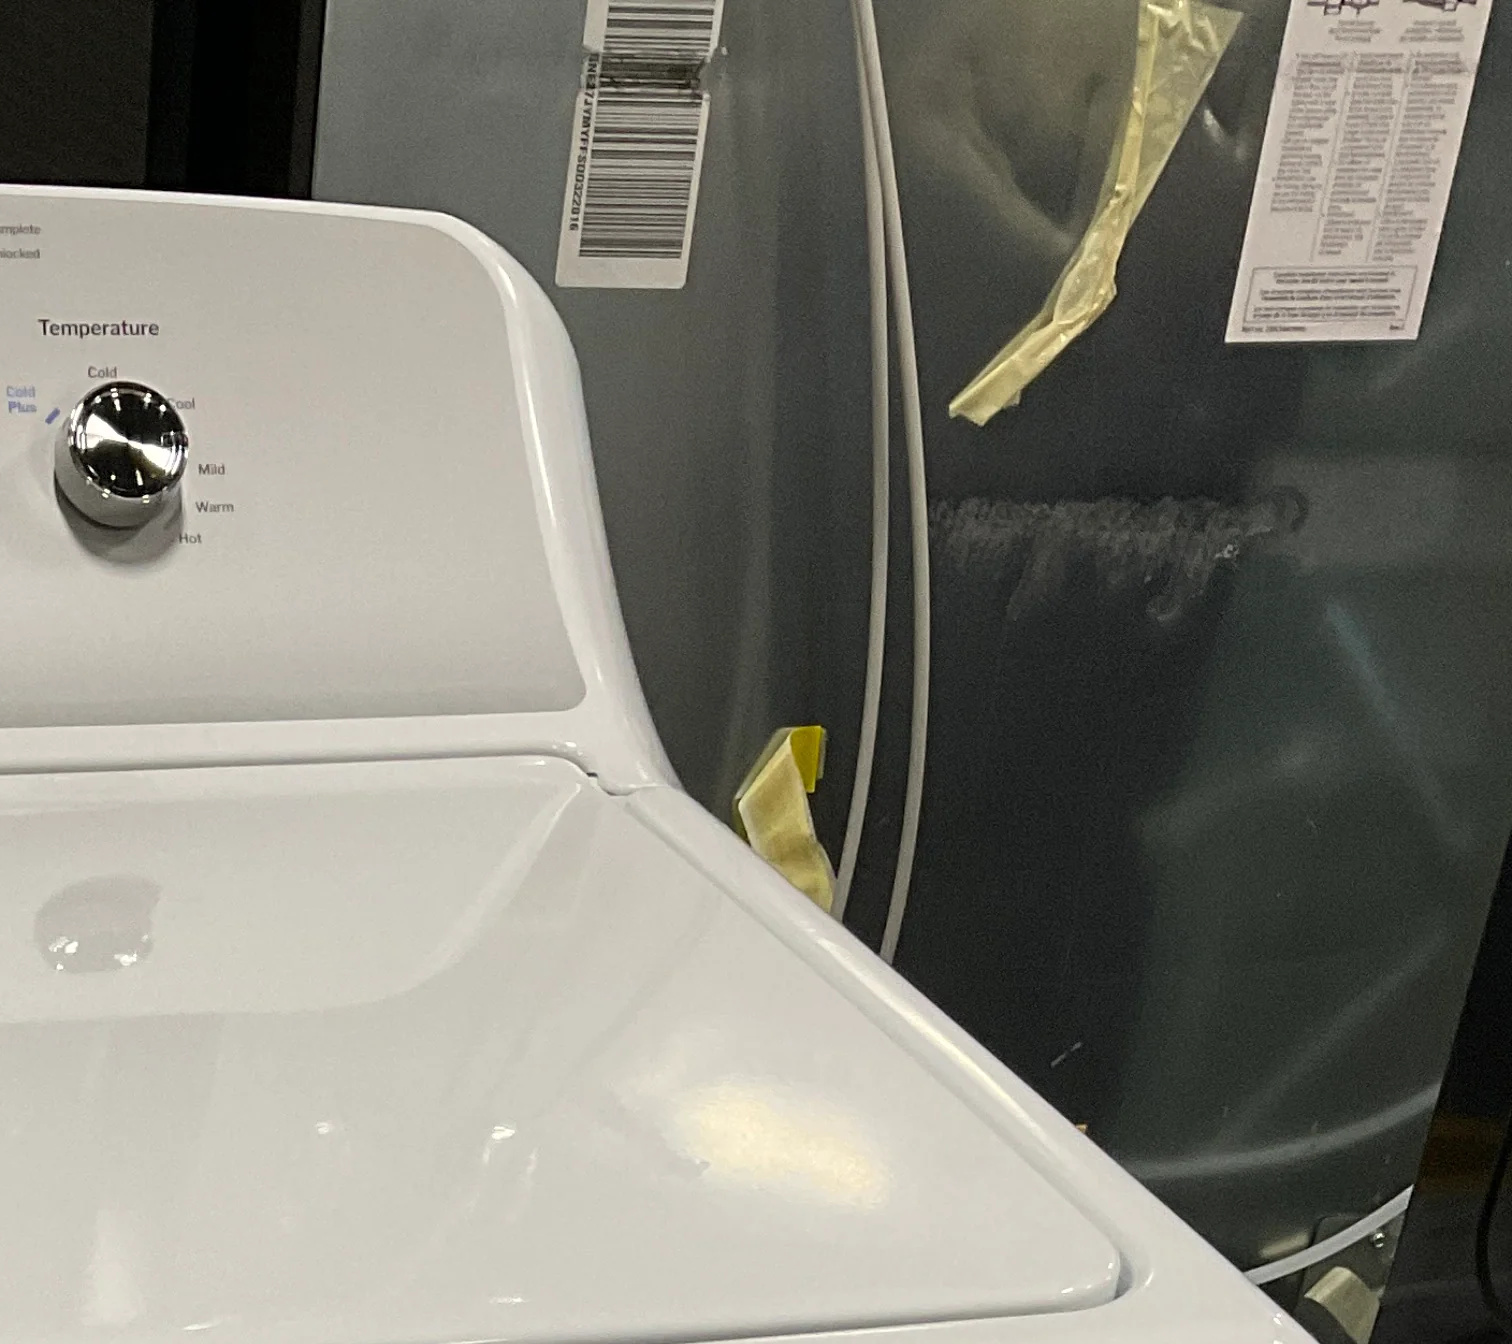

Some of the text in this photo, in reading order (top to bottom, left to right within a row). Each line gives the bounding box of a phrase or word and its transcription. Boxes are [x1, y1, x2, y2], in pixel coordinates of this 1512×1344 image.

[38, 319, 160, 339] Temperature
[87, 366, 118, 379] Cold
[197, 463, 226, 476] Mild
[194, 501, 235, 514] Warm
[178, 533, 203, 545] Hot
